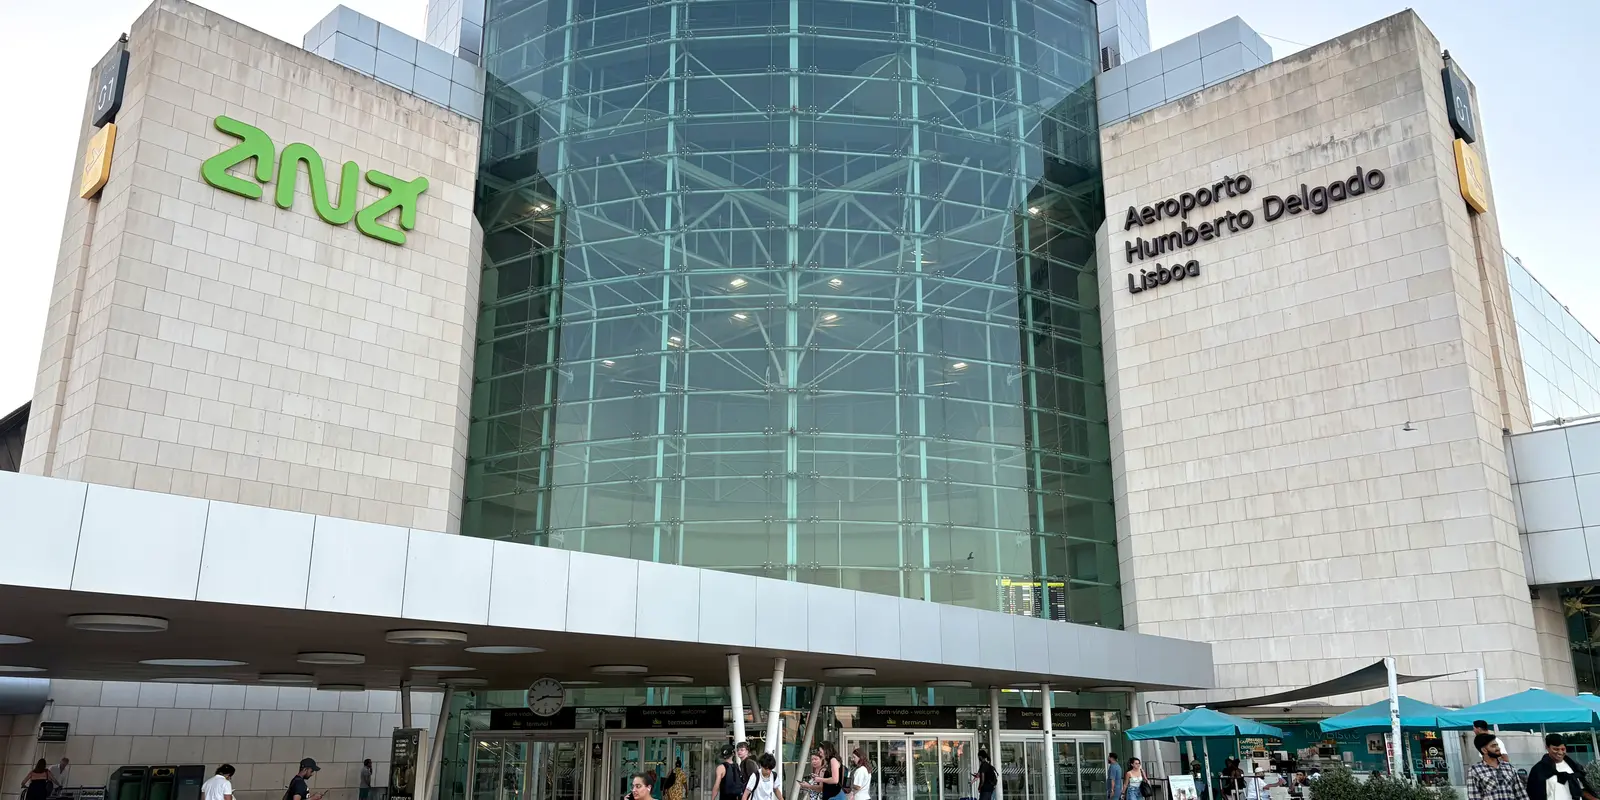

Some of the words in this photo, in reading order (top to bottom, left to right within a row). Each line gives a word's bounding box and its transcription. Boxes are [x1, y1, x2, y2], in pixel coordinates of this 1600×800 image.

[1124, 174, 1253, 231] Aeroporto
[1125, 208, 1254, 264] Humberto
[1262, 166, 1386, 223] Delgado
[1127, 259, 1200, 294] Lisboa
